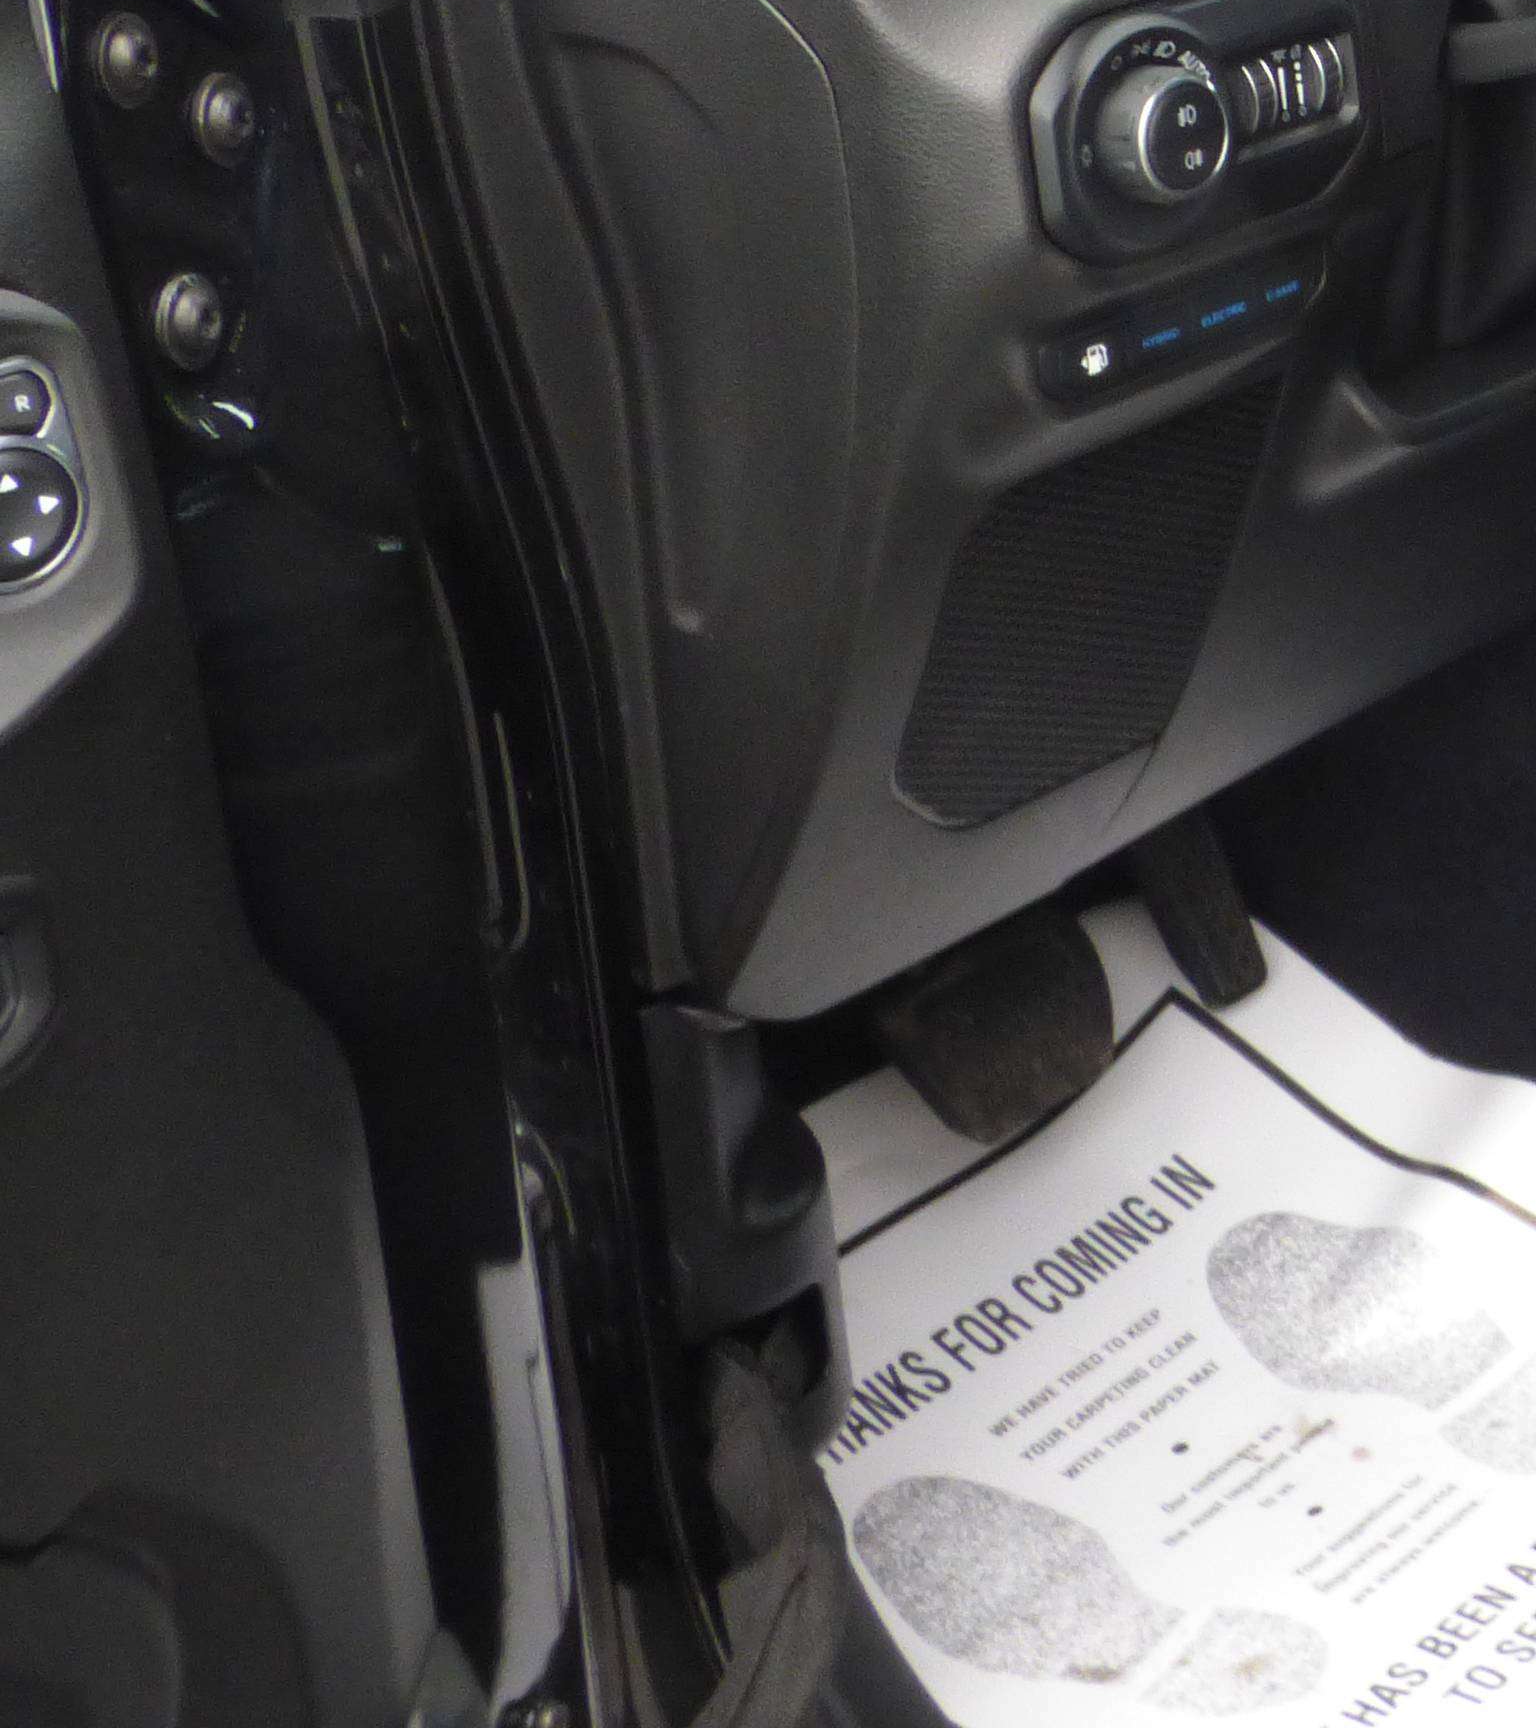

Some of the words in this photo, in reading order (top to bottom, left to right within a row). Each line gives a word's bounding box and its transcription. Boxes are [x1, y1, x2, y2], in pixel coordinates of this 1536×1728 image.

[14, 393, 31, 413] R
[827, 1350, 952, 1465] ANKS
[930, 1297, 1034, 1371] FOR
[1011, 1195, 1174, 1315] COMING
[1150, 1153, 1216, 1211] IN
[988, 1414, 1018, 1438] WE
[1016, 1385, 1060, 1420] HAVE
[1057, 1352, 1104, 1388] TRIED
[1104, 1335, 1128, 1355] TO
[1125, 1308, 1161, 1340] KEEP
[1020, 1426, 1068, 1462] YOUR
[1065, 1365, 1151, 1432] CARPETING
[1148, 1331, 1198, 1370] CLEAN
[1062, 1446, 1105, 1480] WITH
[1103, 1420, 1142, 1449] THIS
[1139, 1384, 1190, 1423] PAPER
[1341, 1662, 1429, 1727] HAS
[1415, 1583, 1518, 1660] BEEN
[1442, 1664, 1508, 1704] TO
